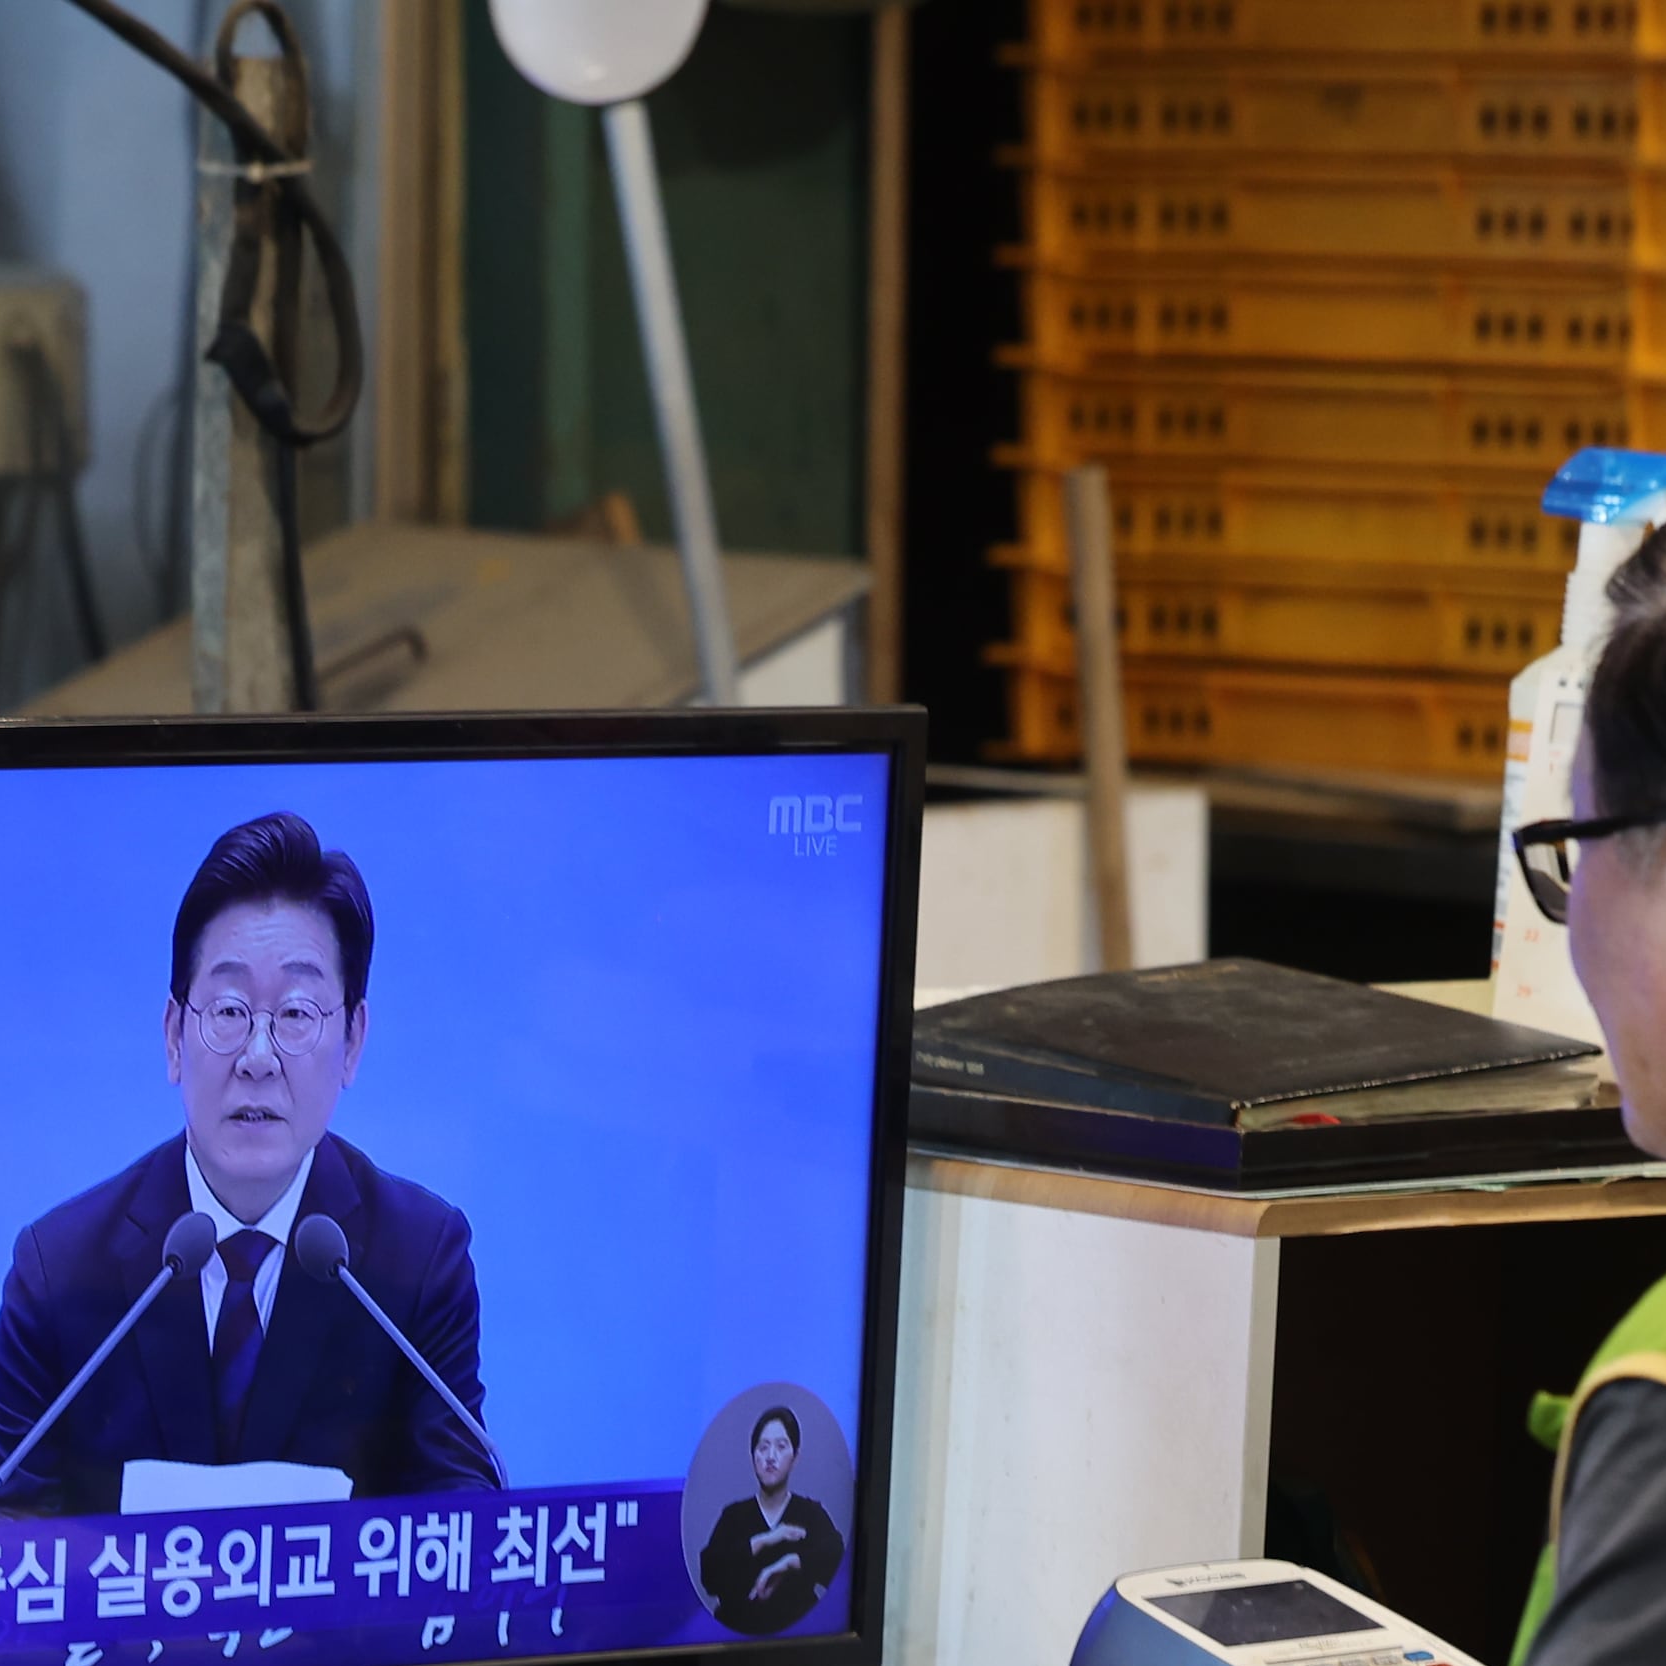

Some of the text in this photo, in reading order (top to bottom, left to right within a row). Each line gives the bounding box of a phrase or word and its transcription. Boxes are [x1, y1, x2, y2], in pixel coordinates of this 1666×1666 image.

[769, 795, 863, 834] MBC
[795, 835, 837, 856] LIVE
[88, 1524, 334, 1619] 실용외교
[353, 1511, 473, 1598] 위해
[491, 1501, 639, 1588] 최선"
